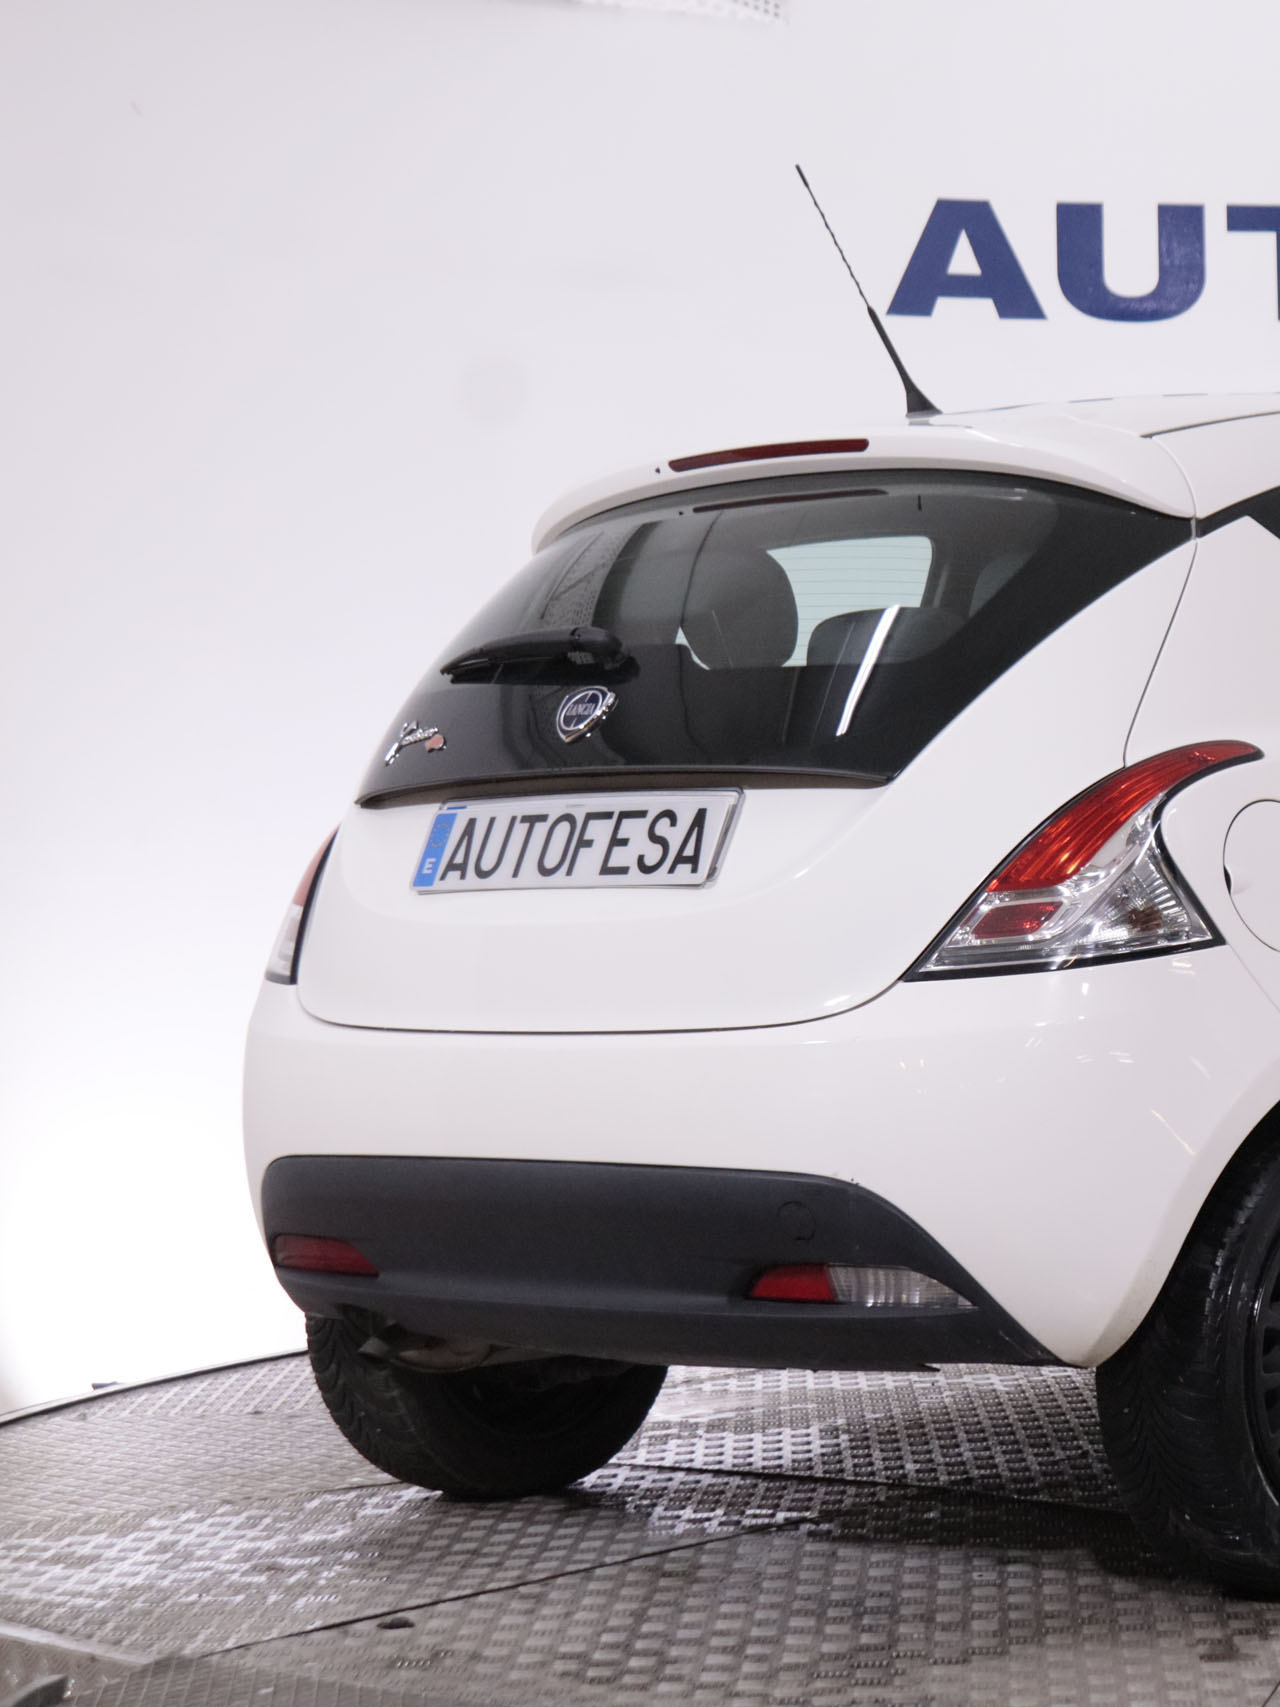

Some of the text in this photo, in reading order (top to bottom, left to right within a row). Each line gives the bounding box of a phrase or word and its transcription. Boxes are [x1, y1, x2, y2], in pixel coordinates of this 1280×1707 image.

[566, 703, 596, 716] LANCIA
[439, 808, 707, 881] AUTOFESA
[422, 858, 434, 875] E
